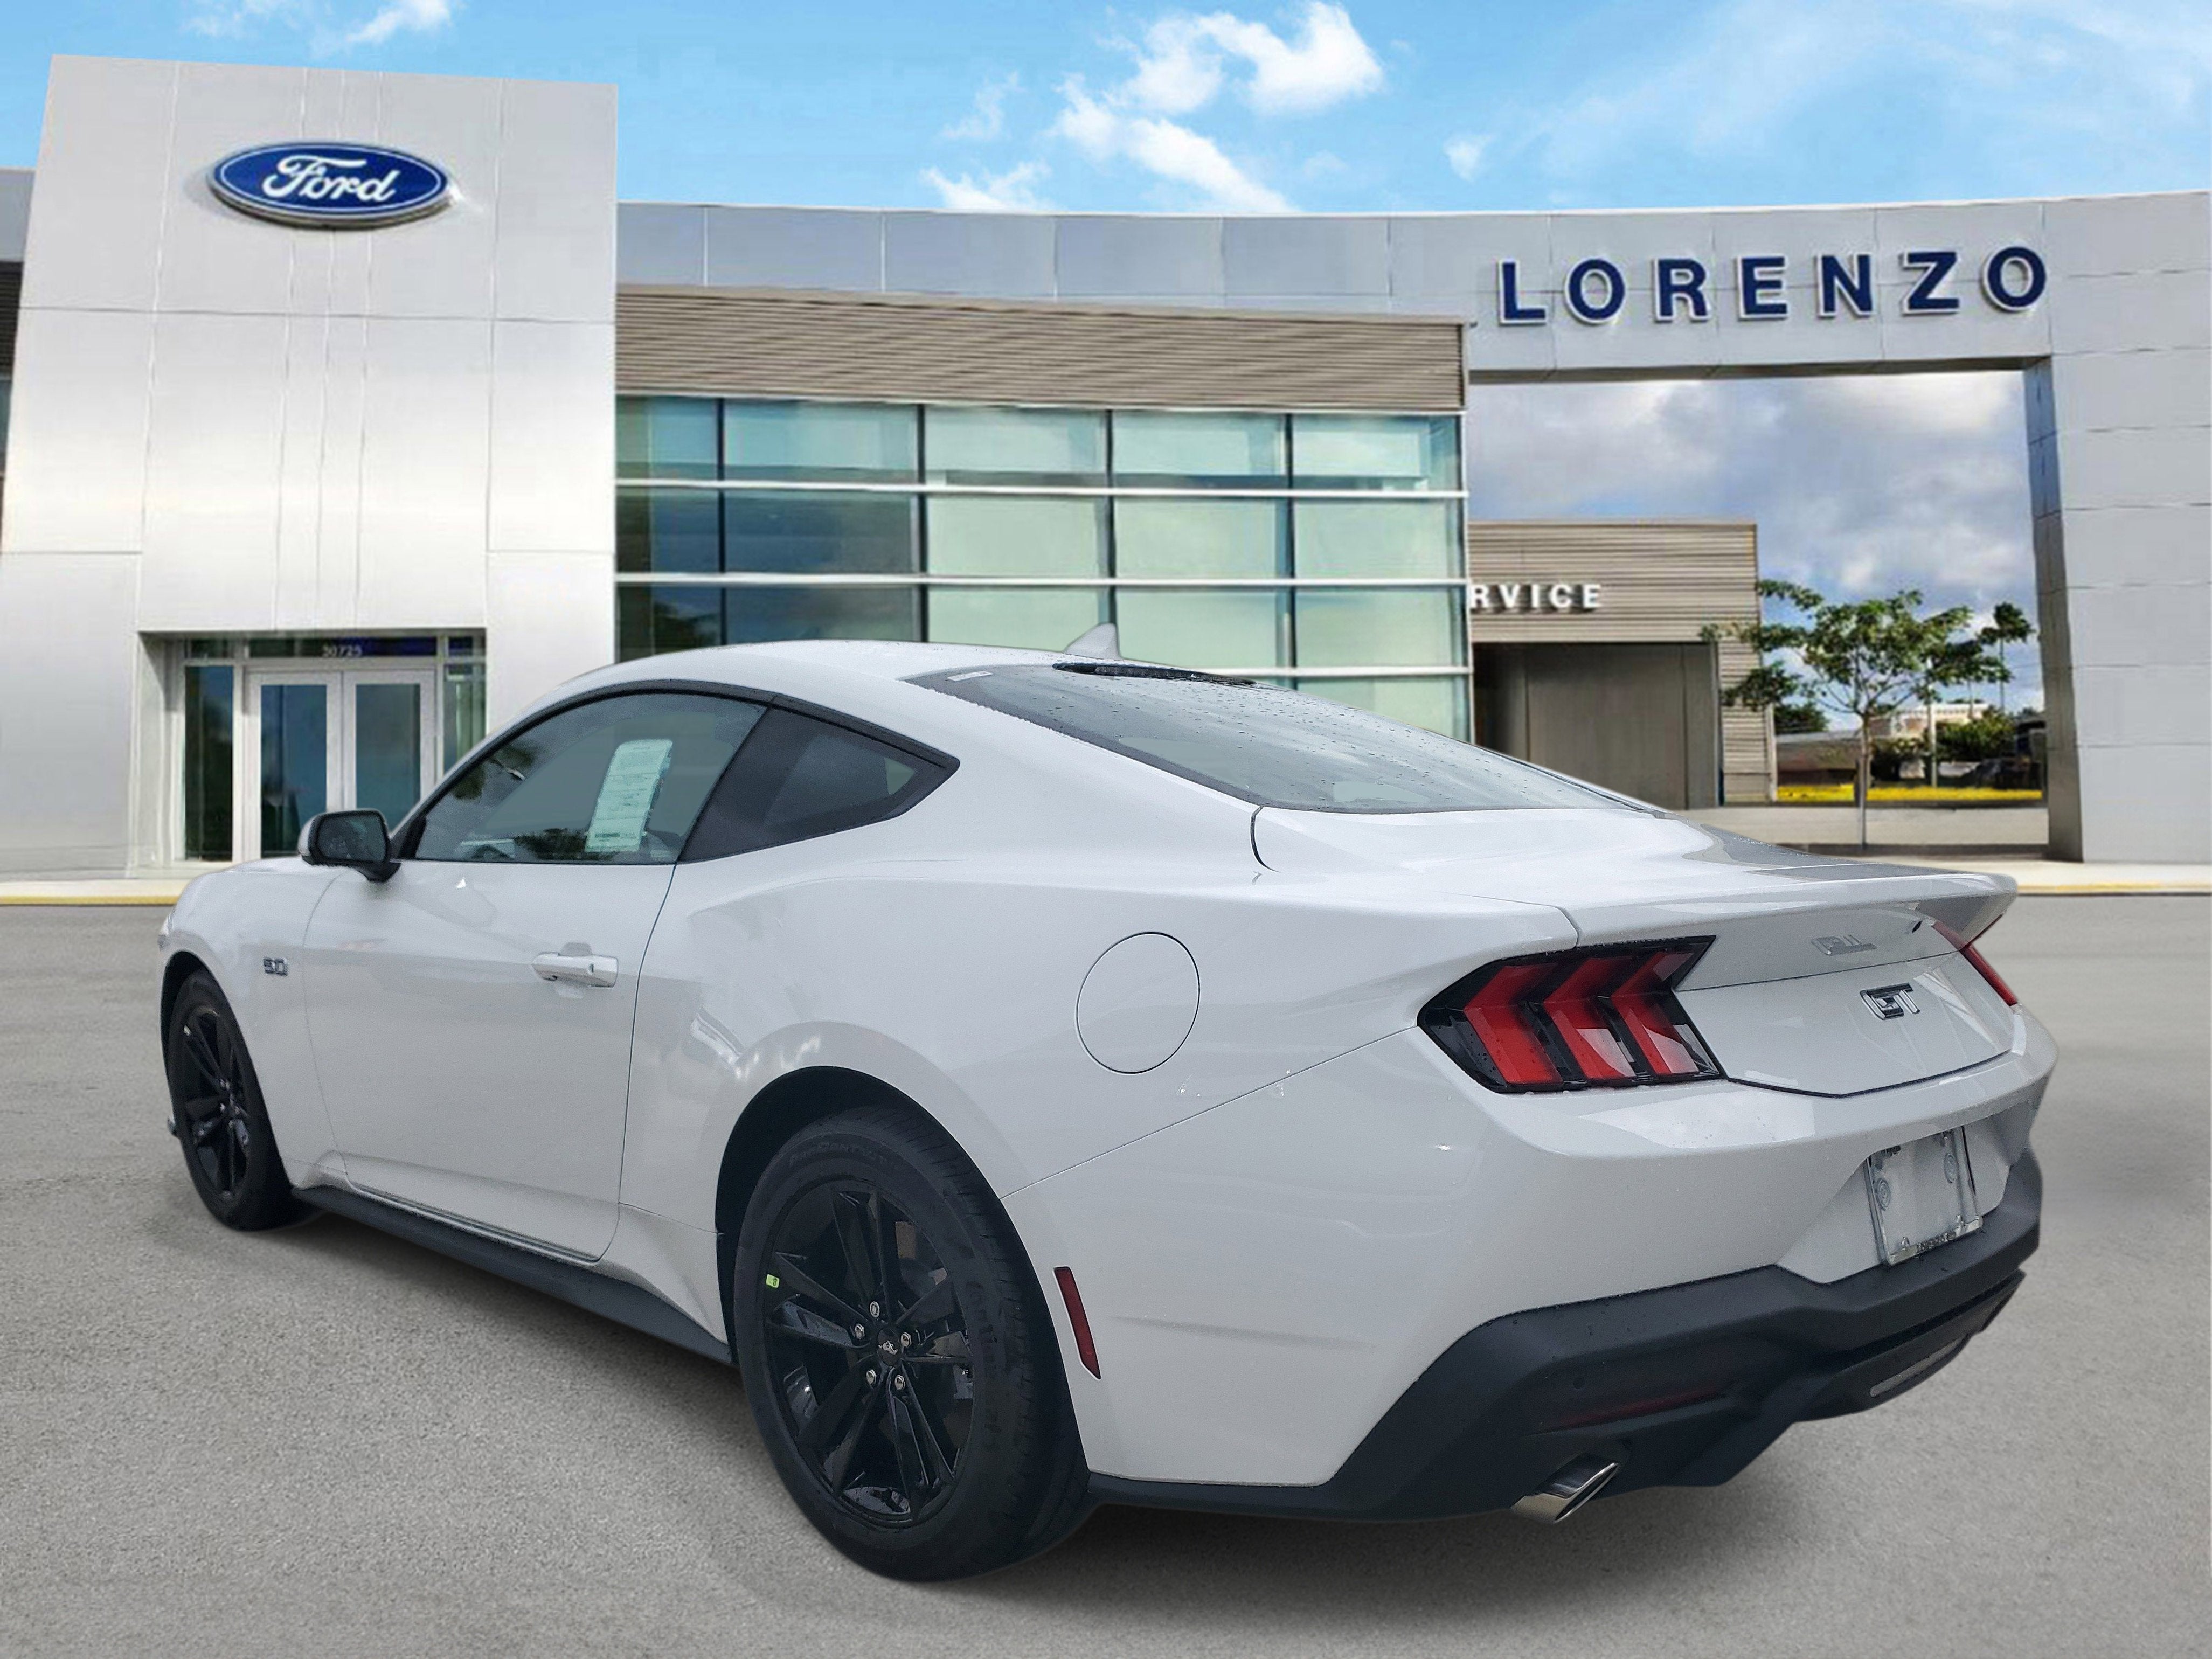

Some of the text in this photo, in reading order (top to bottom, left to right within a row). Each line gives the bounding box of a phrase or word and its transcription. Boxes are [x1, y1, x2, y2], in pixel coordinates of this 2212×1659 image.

[262, 154, 400, 202] Ford
[1497, 246, 2047, 324] LORENZO
[1859, 982, 1920, 1021] GT
